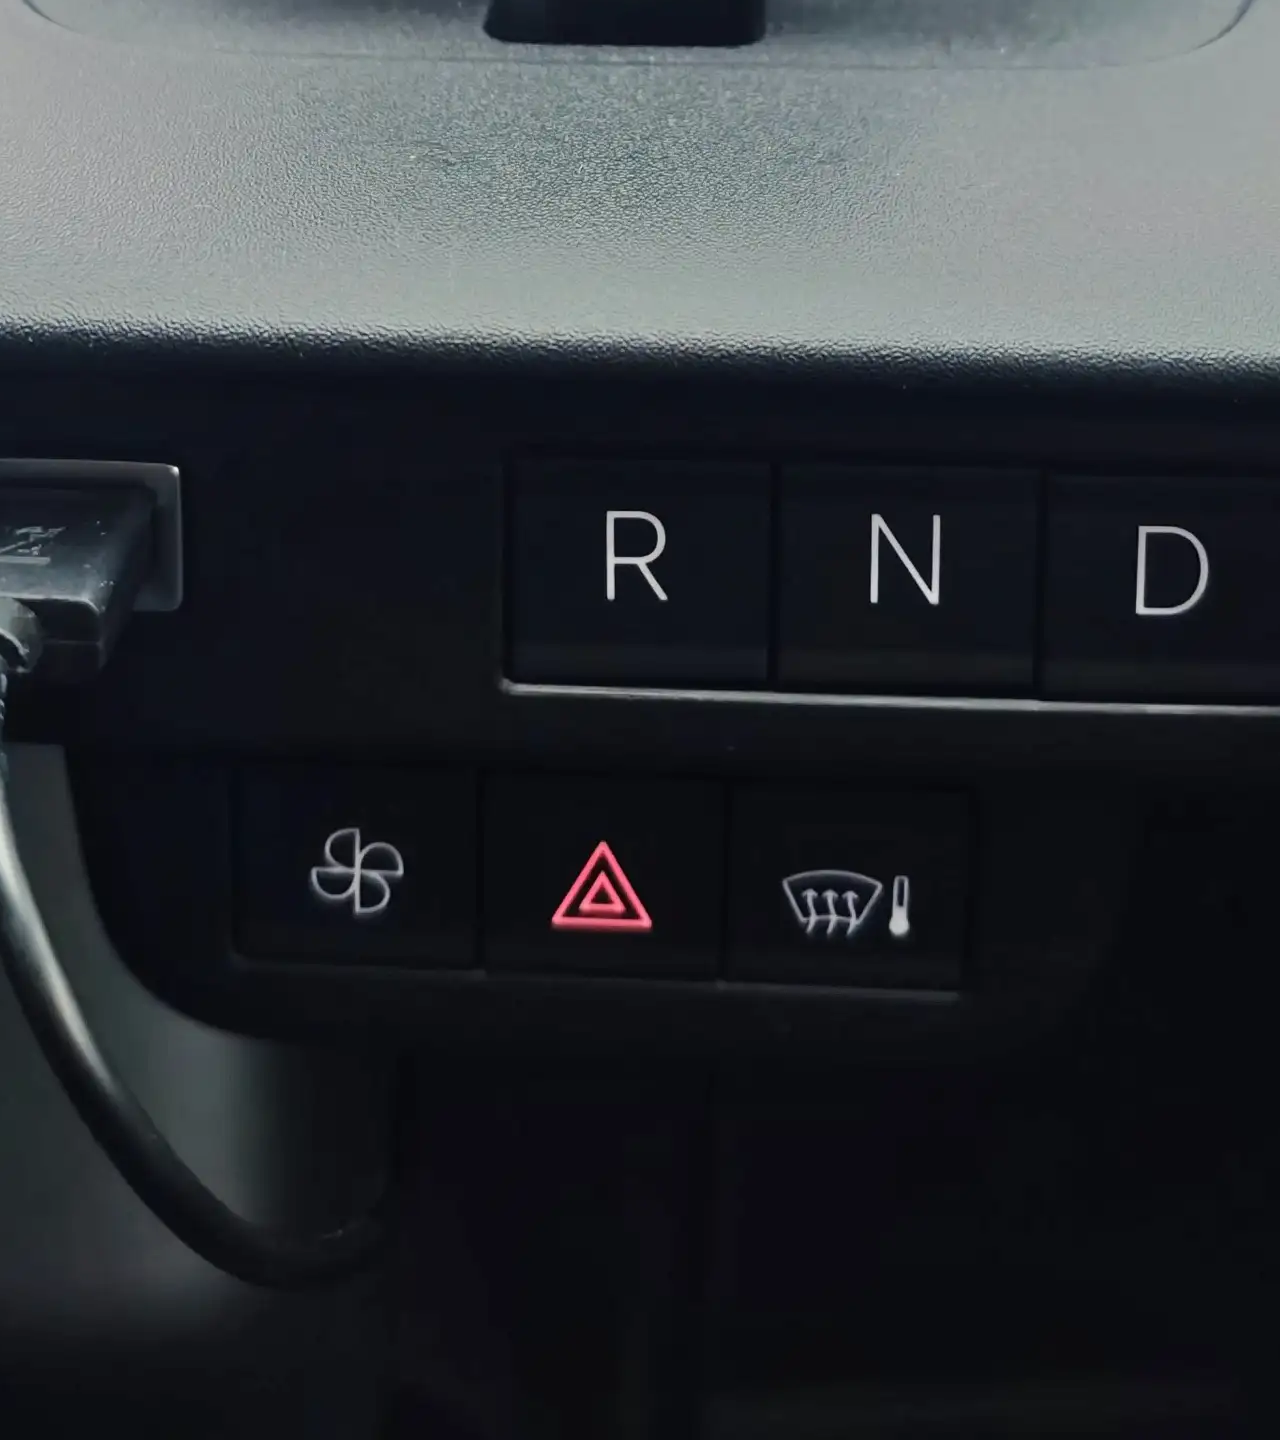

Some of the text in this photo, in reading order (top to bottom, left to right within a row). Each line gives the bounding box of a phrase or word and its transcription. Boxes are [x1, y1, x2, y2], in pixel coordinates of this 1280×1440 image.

[605, 509, 1210, 617] R N D
